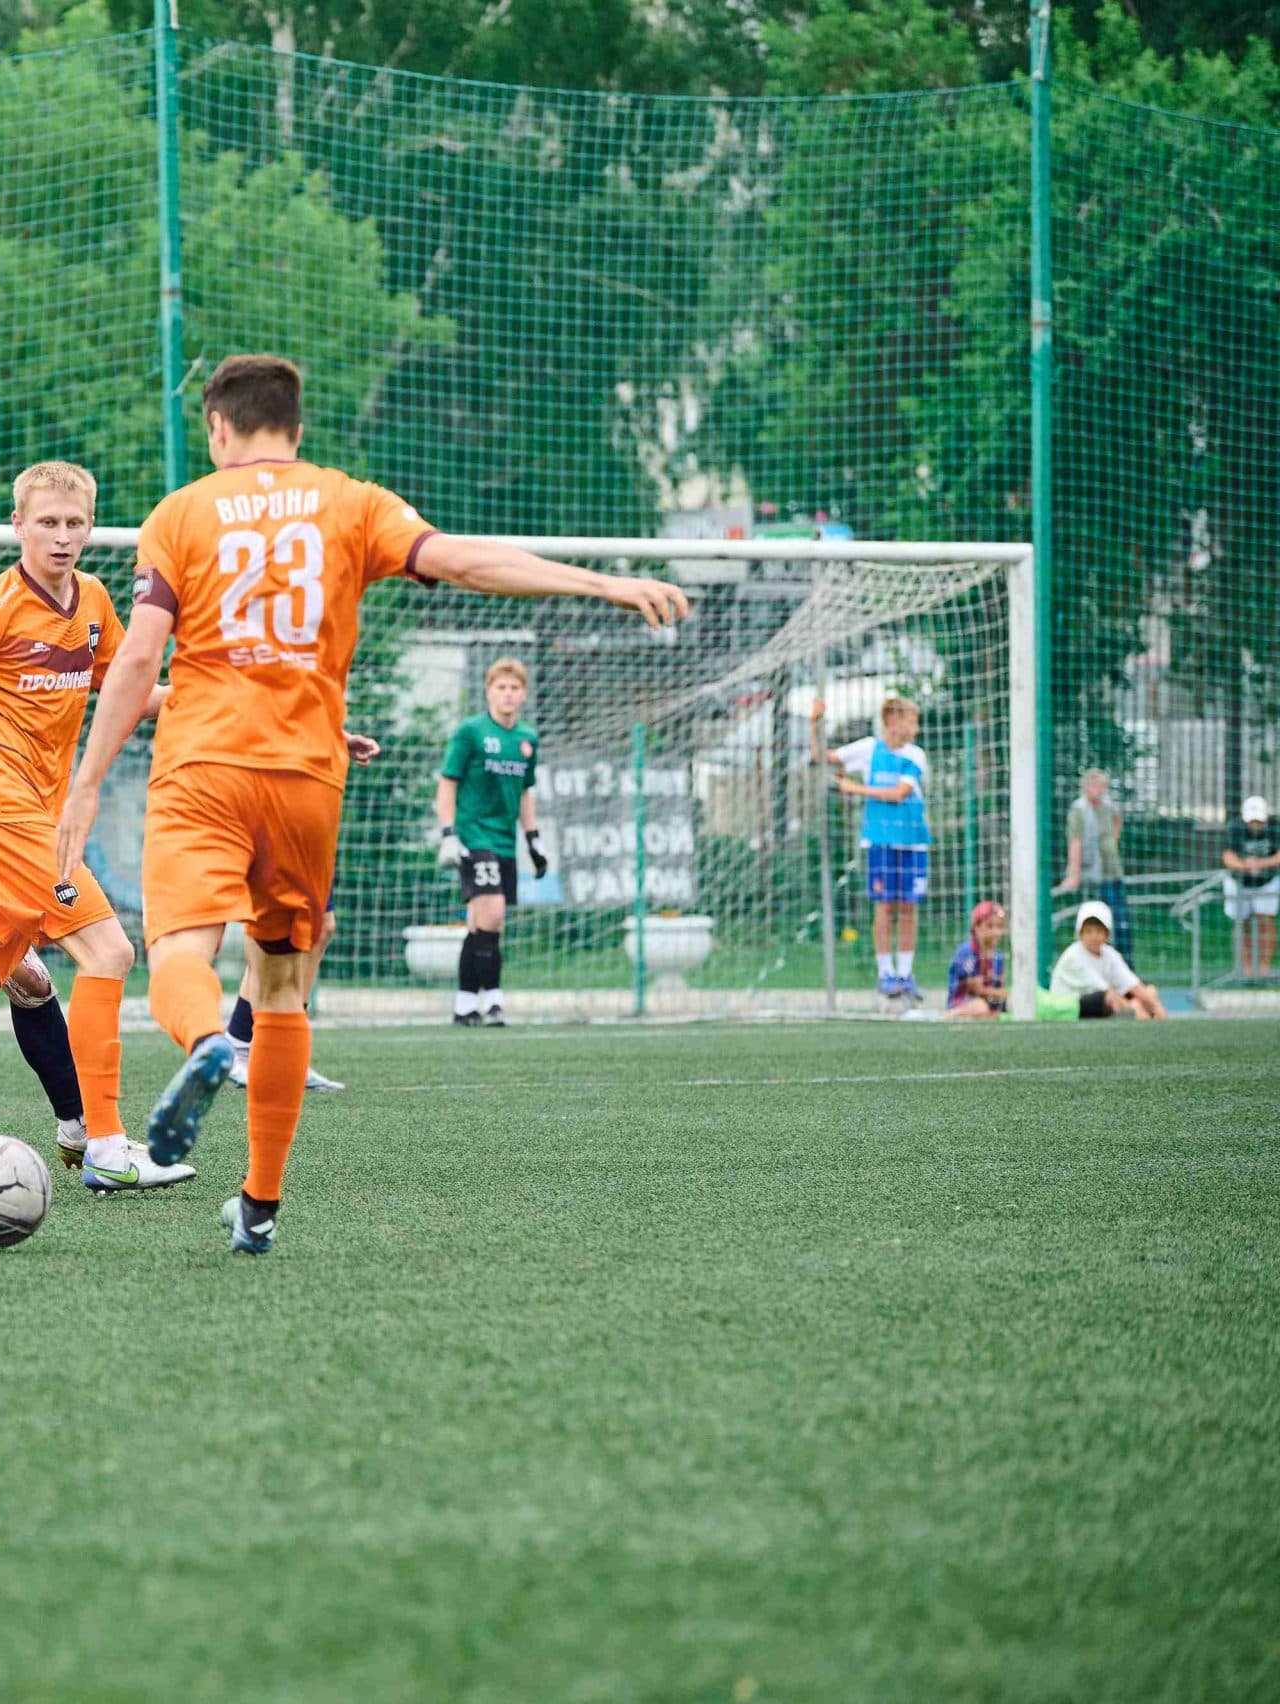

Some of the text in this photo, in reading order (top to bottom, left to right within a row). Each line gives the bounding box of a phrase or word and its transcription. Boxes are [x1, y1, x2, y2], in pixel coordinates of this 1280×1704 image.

[215, 487, 320, 525] ВОРОНА
[218, 521, 324, 645] 23
[473, 861, 501, 886] 33
